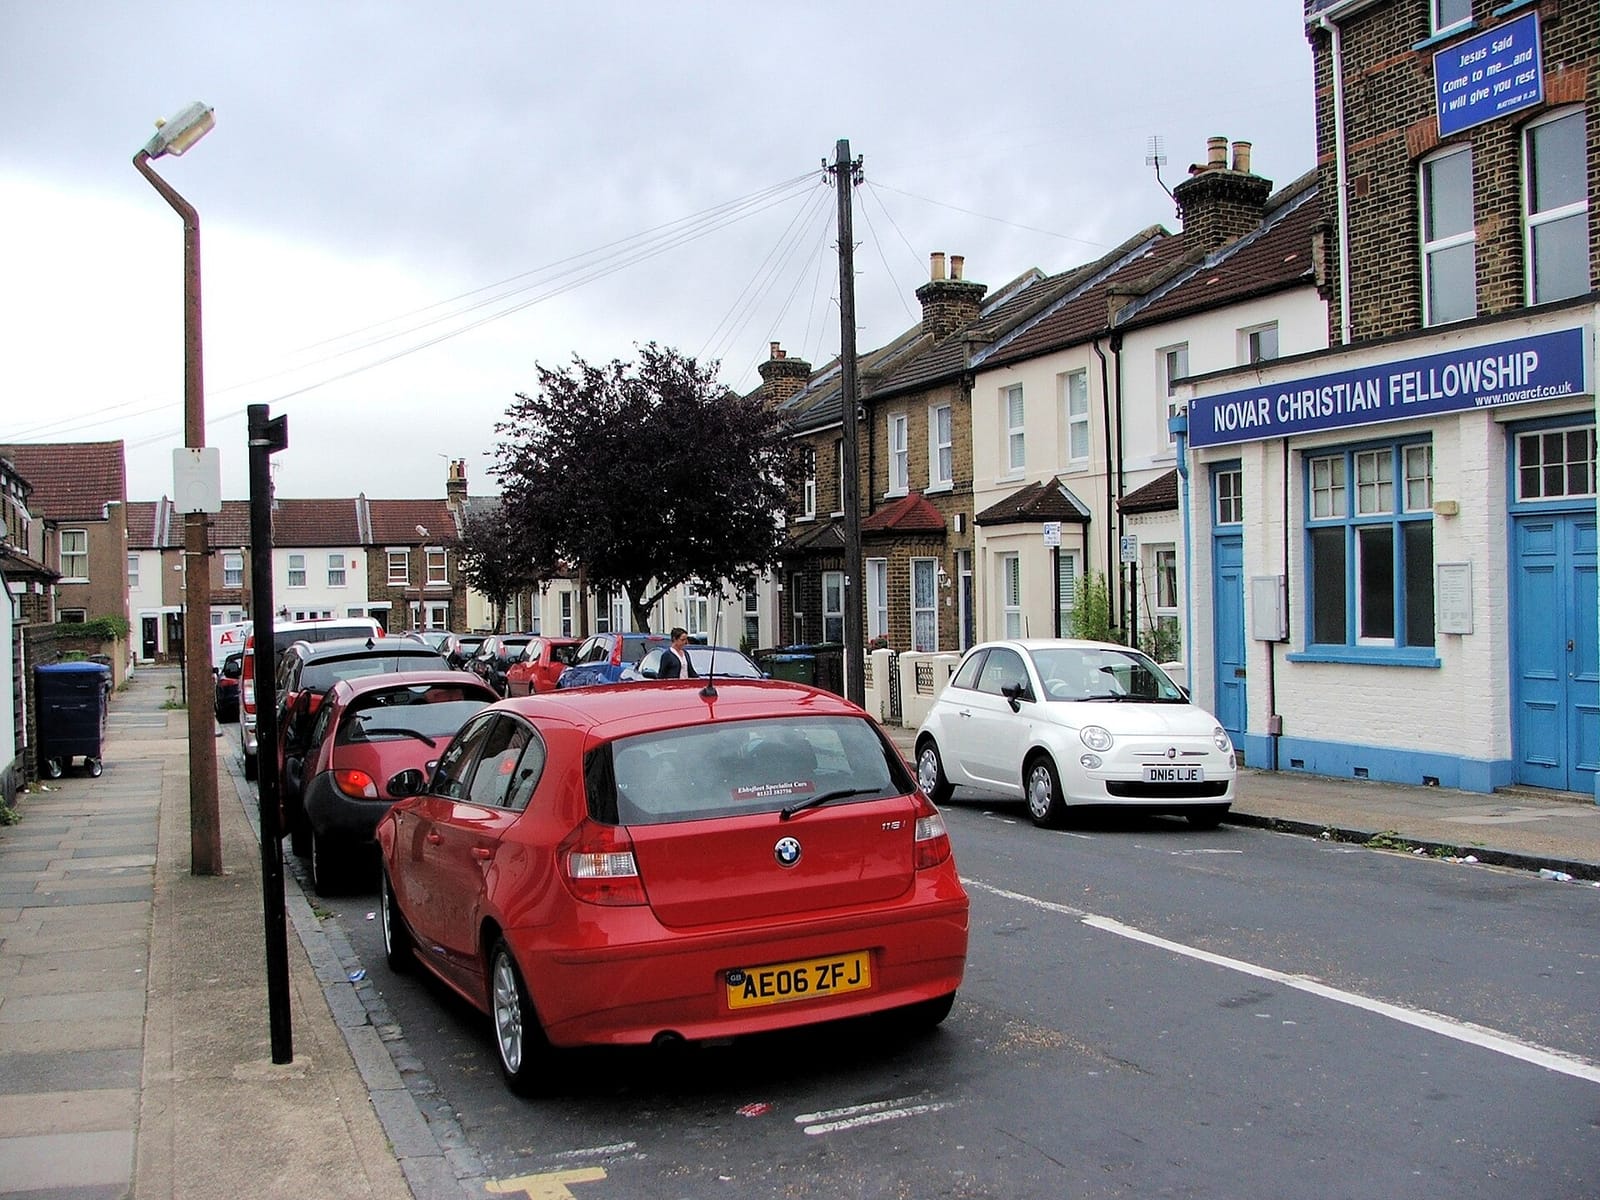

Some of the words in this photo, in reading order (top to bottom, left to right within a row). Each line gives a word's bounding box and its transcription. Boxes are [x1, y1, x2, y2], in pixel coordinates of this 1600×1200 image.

[1459, 47, 1487, 67] Jesus
[1491, 35, 1513, 54] Said
[1442, 73, 1468, 94] Come
[1472, 69, 1483, 83] to
[1442, 102, 1447, 114] I
[1449, 94, 1466, 111] will
[1470, 87, 1490, 105] give
[1493, 79, 1511, 97] you
[1515, 69, 1536, 86] rest
[1214, 398, 1271, 432] NOVAR
[1276, 378, 1381, 423] CHRISTIAN
[1389, 351, 1538, 405] FELLOWSHIP
[1475, 381, 1572, 406] www.novarcf.co.uk
[1150, 769, 1174, 780] DN15
[1177, 769, 1197, 780] LJE
[743, 968, 808, 999] AE06
[815, 959, 861, 990] ZFJ
